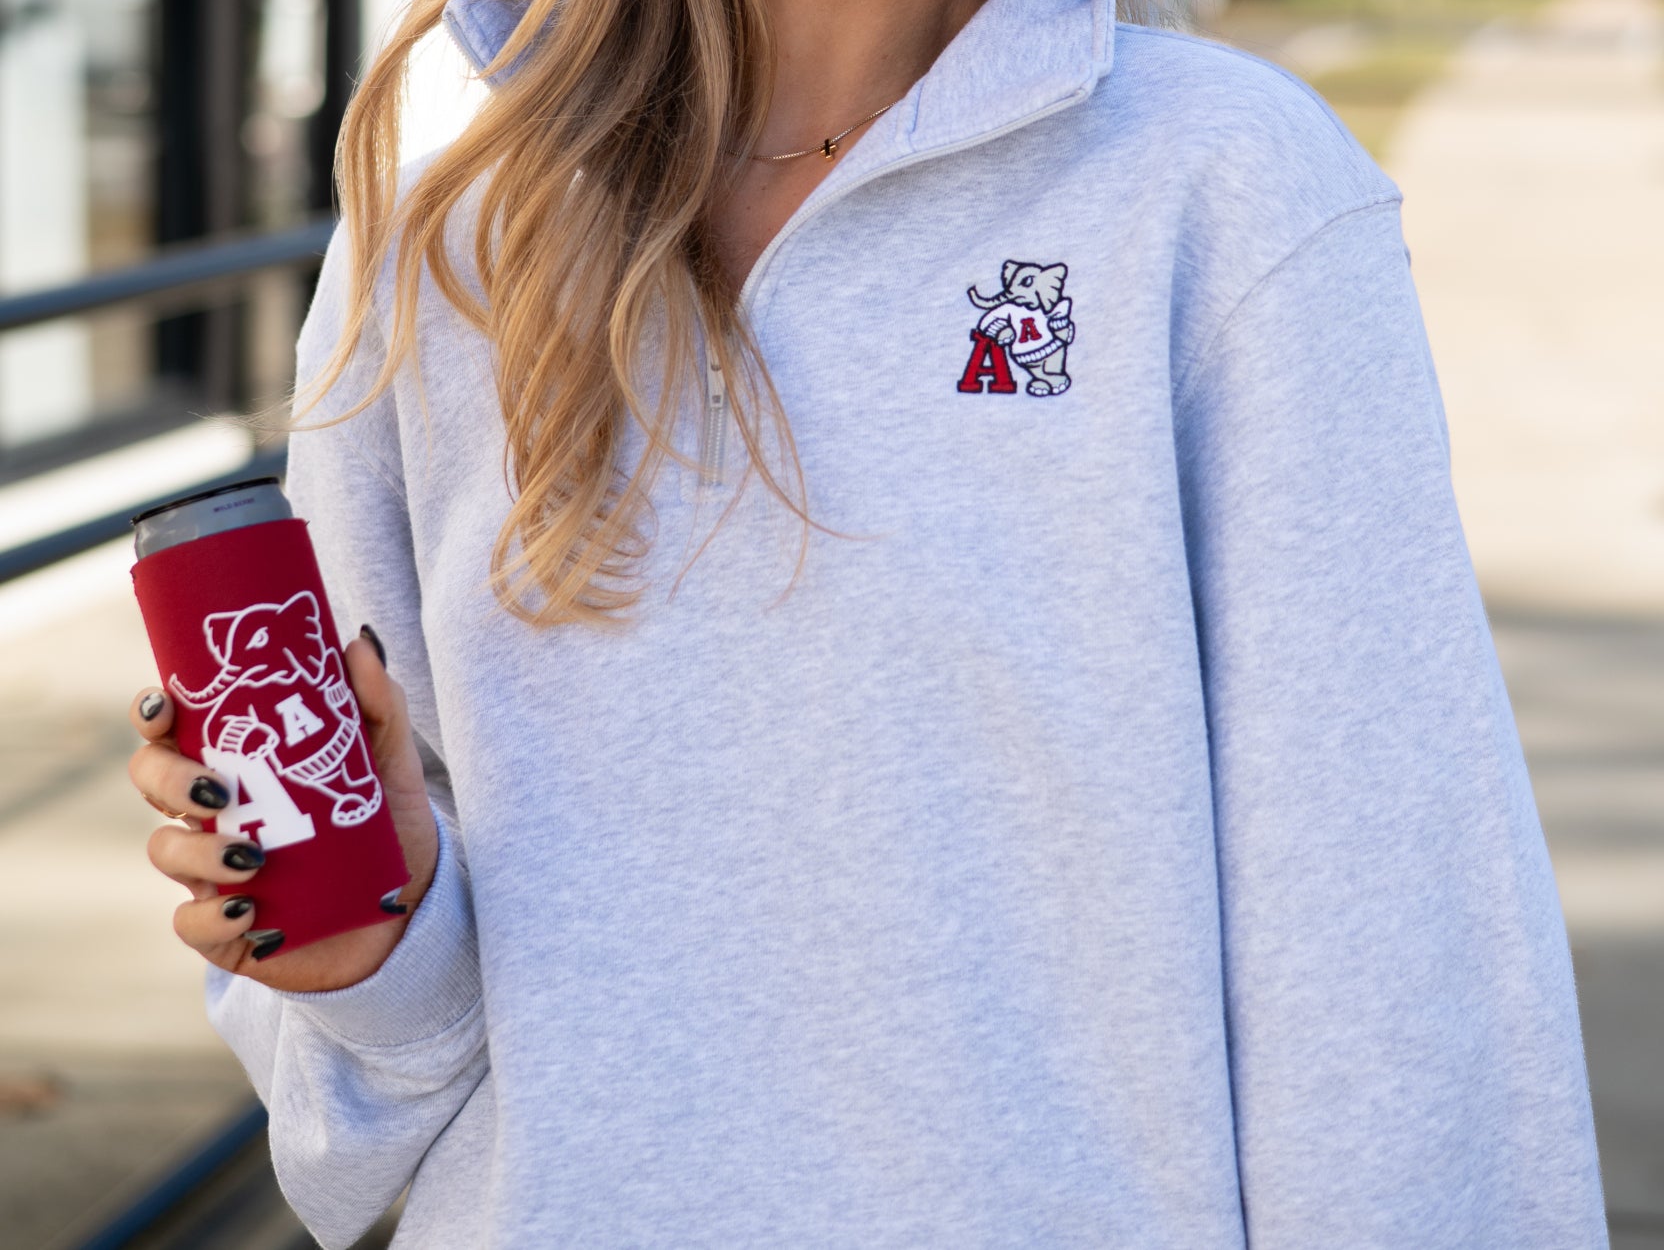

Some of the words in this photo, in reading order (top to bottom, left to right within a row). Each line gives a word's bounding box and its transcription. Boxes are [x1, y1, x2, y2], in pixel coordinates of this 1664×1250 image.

[1018, 317, 1042, 343] A
[957, 328, 1017, 394] A
[274, 693, 324, 748] A
[201, 744, 317, 853] A
